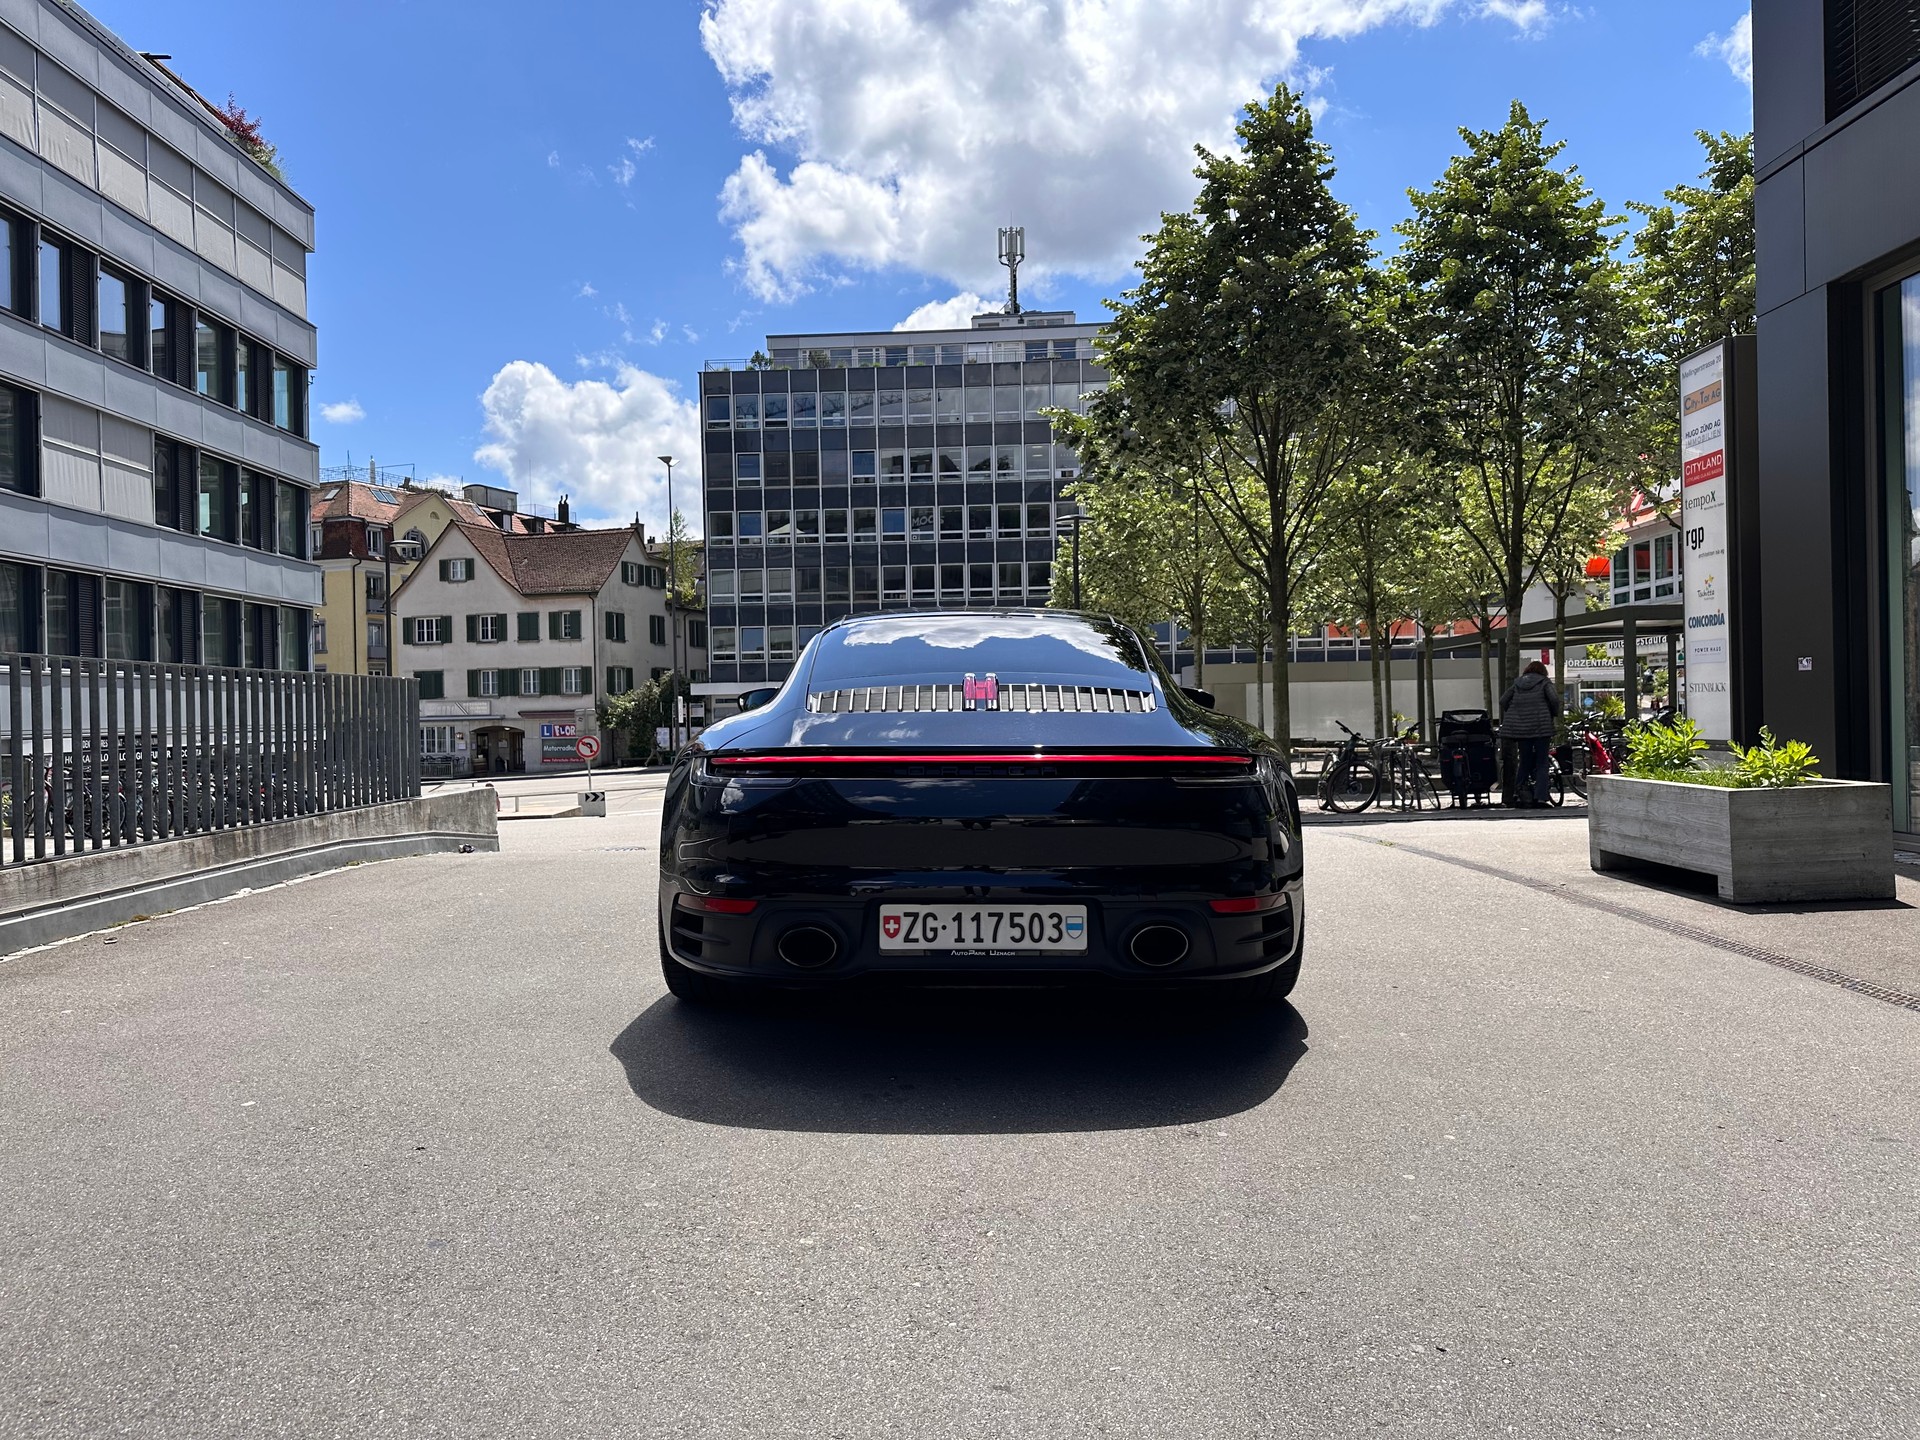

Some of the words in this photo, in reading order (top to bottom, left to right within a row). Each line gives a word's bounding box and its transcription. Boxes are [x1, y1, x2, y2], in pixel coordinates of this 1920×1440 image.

[1685, 426, 1699, 440] HUGO
[1713, 419, 1721, 428] AG
[1685, 454, 1723, 476] CITYLAND
[1685, 526, 1704, 550] rgp
[543, 725, 550, 736] L
[554, 725, 576, 737] FLOR
[543, 744, 577, 752] Motorradku
